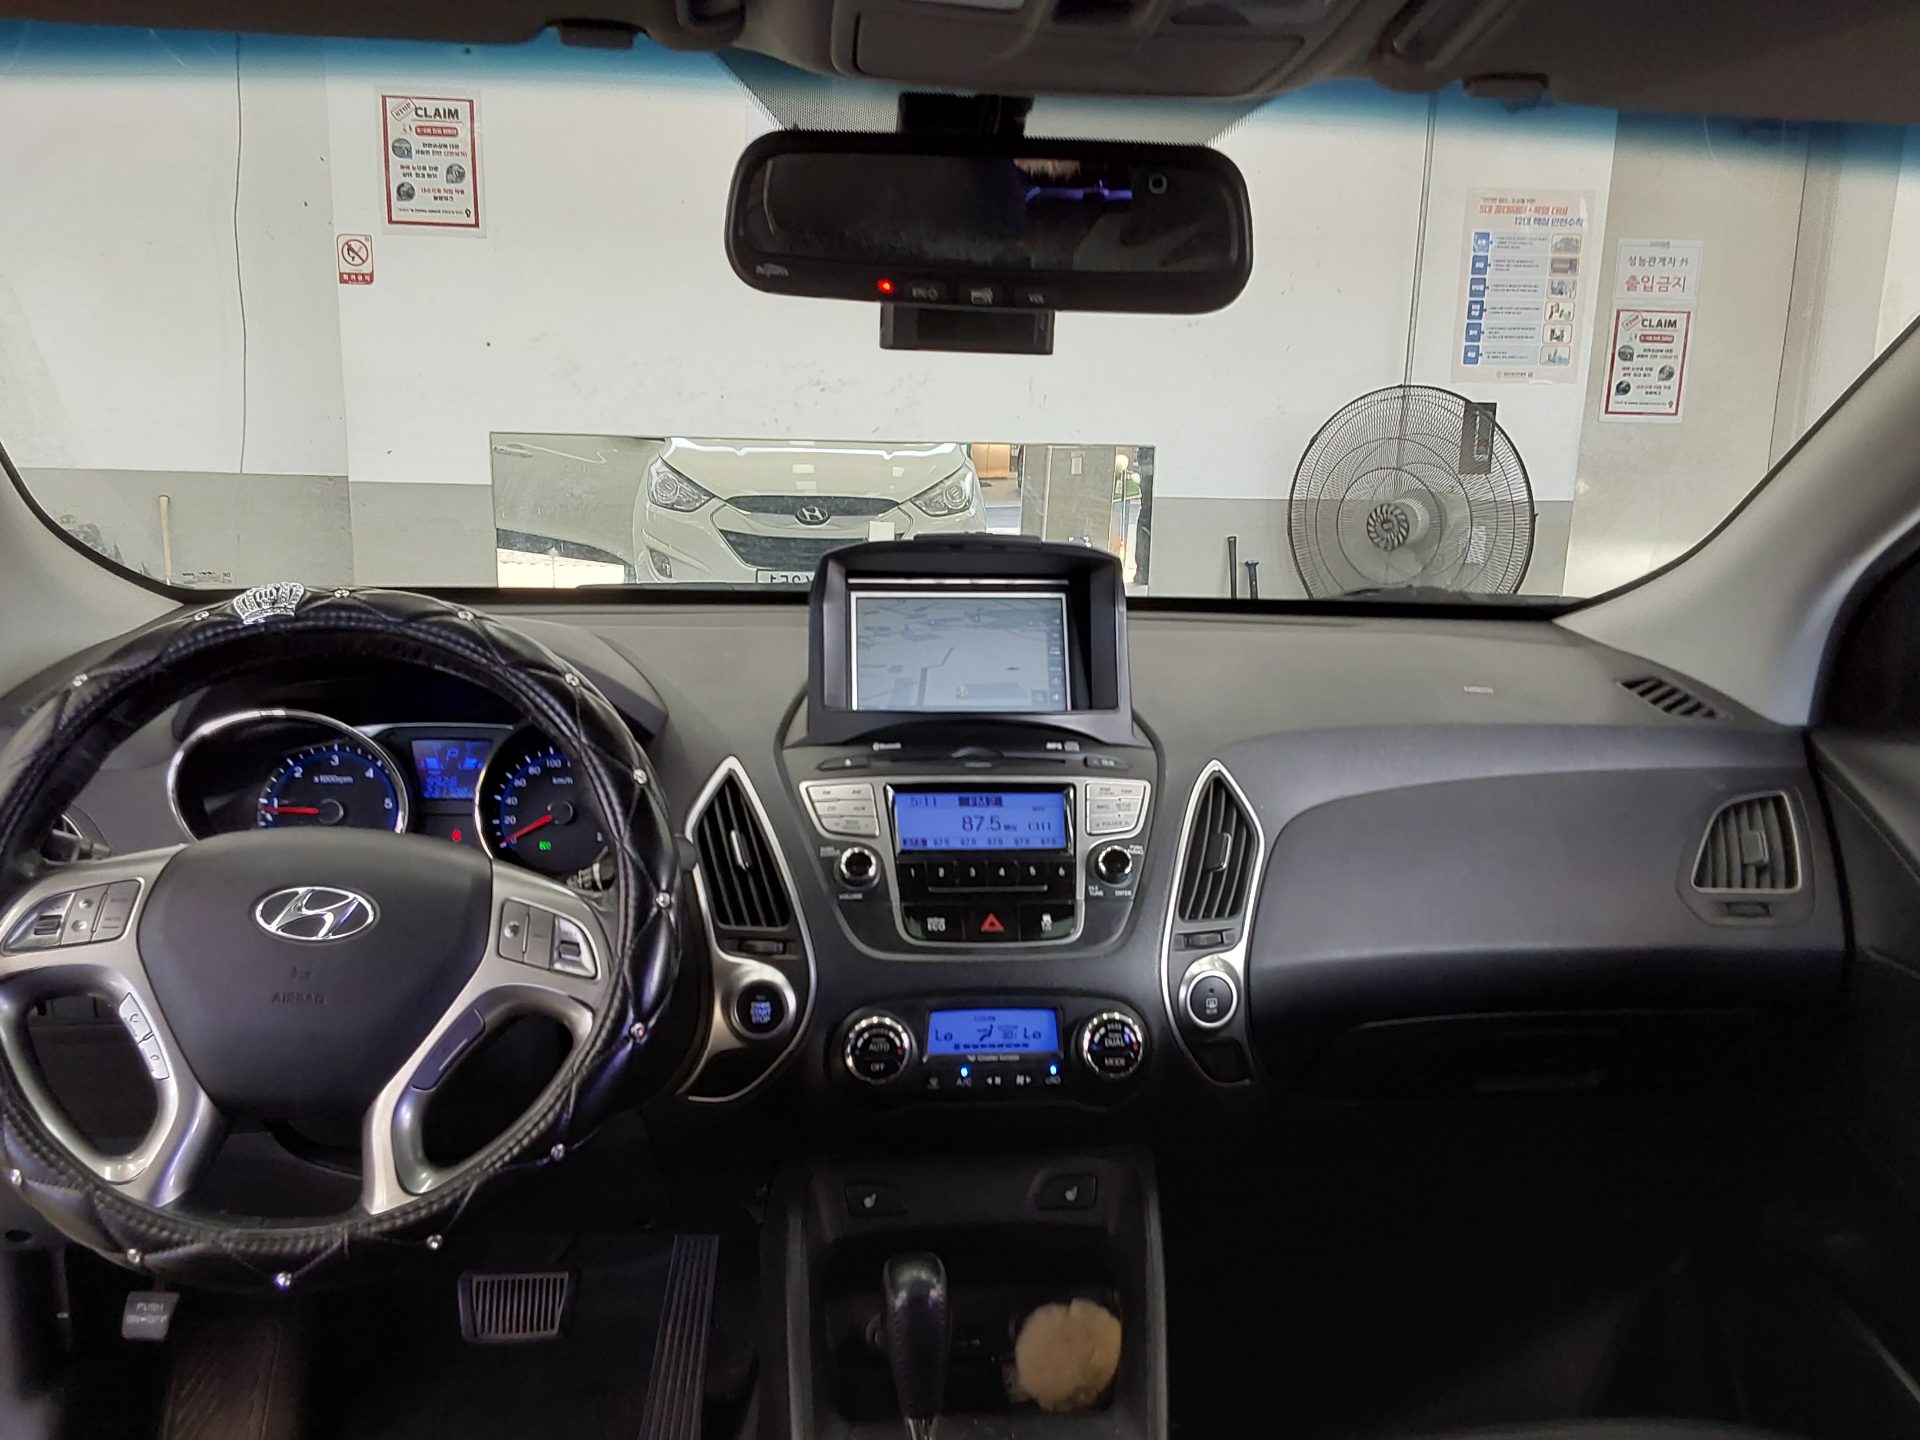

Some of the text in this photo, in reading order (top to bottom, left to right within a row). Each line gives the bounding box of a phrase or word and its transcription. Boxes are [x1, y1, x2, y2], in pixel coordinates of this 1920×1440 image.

[414, 106, 460, 120] CLAIM
[1628, 255, 1676, 268] 성능관계자
[1625, 274, 1686, 293] 출입금지
[1641, 318, 1678, 329] CLAIM
[330, 754, 340, 767] 3
[546, 758, 562, 768] 100
[294, 766, 304, 778] 2
[365, 767, 374, 779] 4
[384, 797, 393, 809] 5
[505, 796, 518, 806] 40
[504, 815, 517, 825] 20
[961, 814, 1001, 832] 87.5
[910, 866, 915, 878] 1
[998, 866, 1006, 878] 4
[935, 1029, 953, 1041] Lo
[1023, 1027, 1042, 1040] Lo
[869, 1042, 890, 1052] AUTO
[1104, 1037, 1126, 1048] DUAL
[870, 1062, 885, 1072] OFF
[1104, 1056, 1126, 1067] MODE
